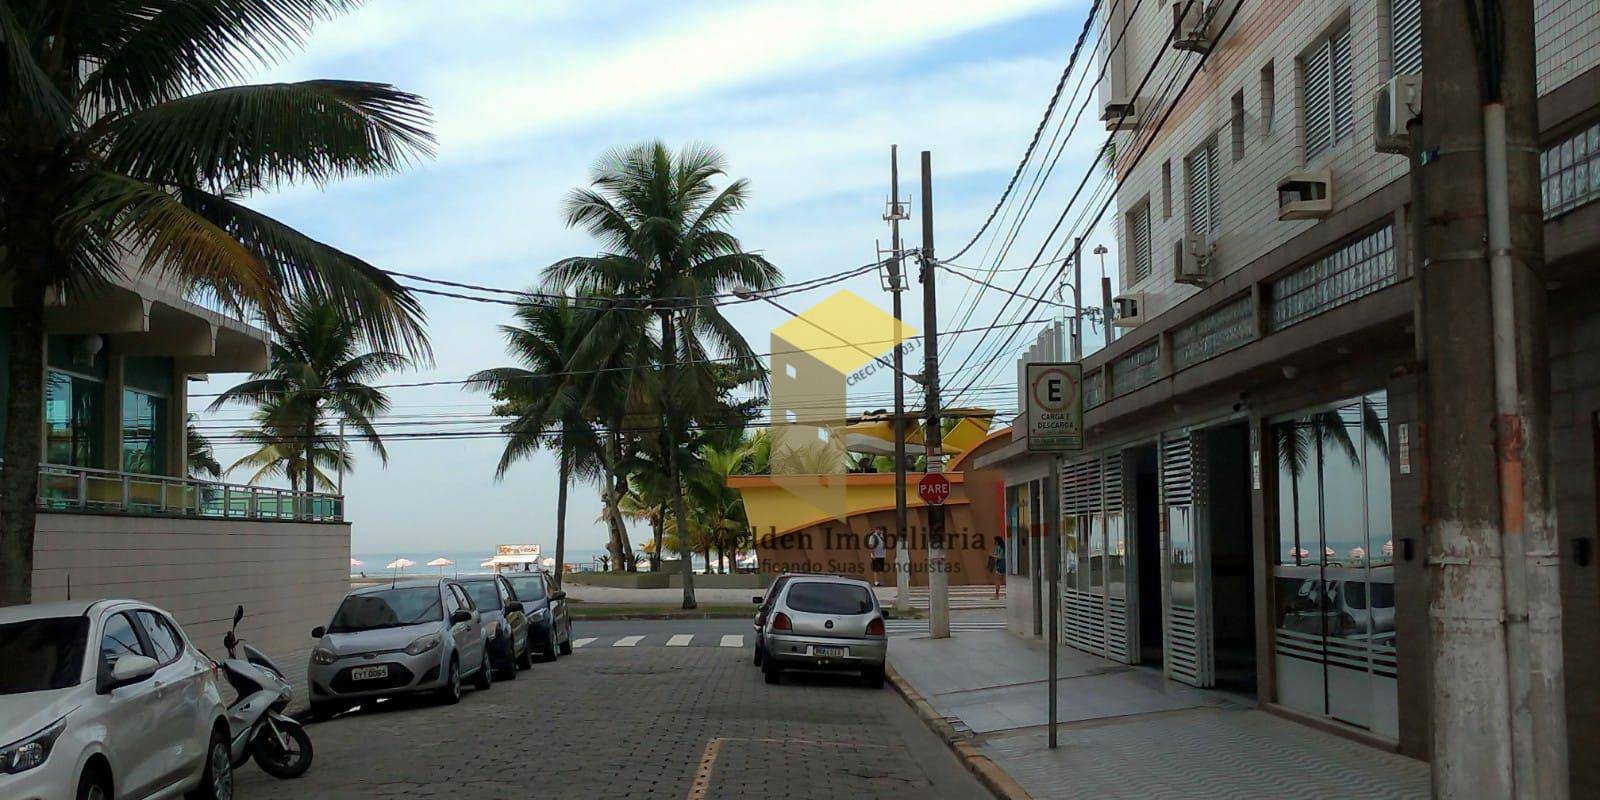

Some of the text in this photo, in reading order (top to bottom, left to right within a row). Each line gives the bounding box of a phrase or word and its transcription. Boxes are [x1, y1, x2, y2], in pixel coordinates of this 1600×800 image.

[1048, 379, 1062, 402] E
[1037, 421, 1074, 429] DESCARGA
[920, 483, 949, 495] PARE
